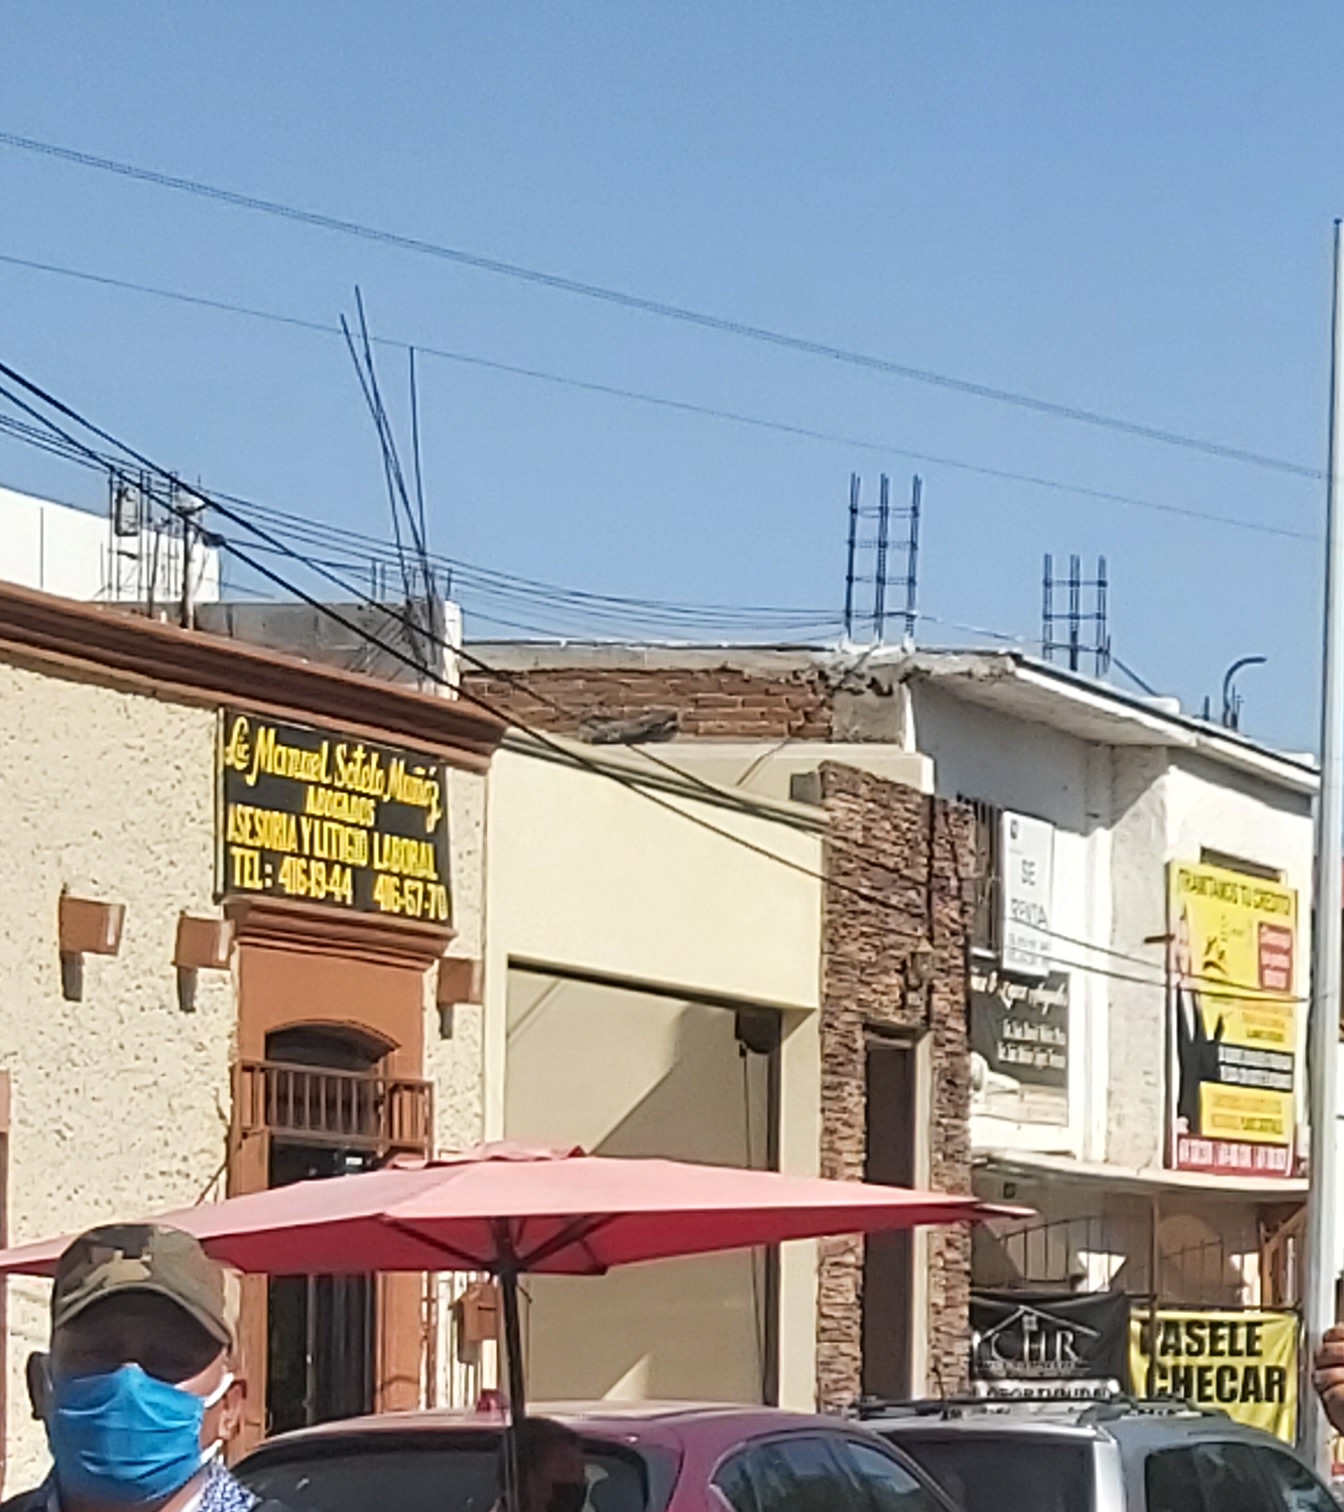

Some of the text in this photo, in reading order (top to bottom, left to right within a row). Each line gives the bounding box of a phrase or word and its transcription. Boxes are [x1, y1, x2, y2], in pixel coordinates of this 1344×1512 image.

[306, 785, 377, 827] ABOGADOS
[226, 803, 299, 853] ASESORIA
[372, 831, 440, 881] LABORAL
[1145, 1364, 1288, 1404] CHECAR
